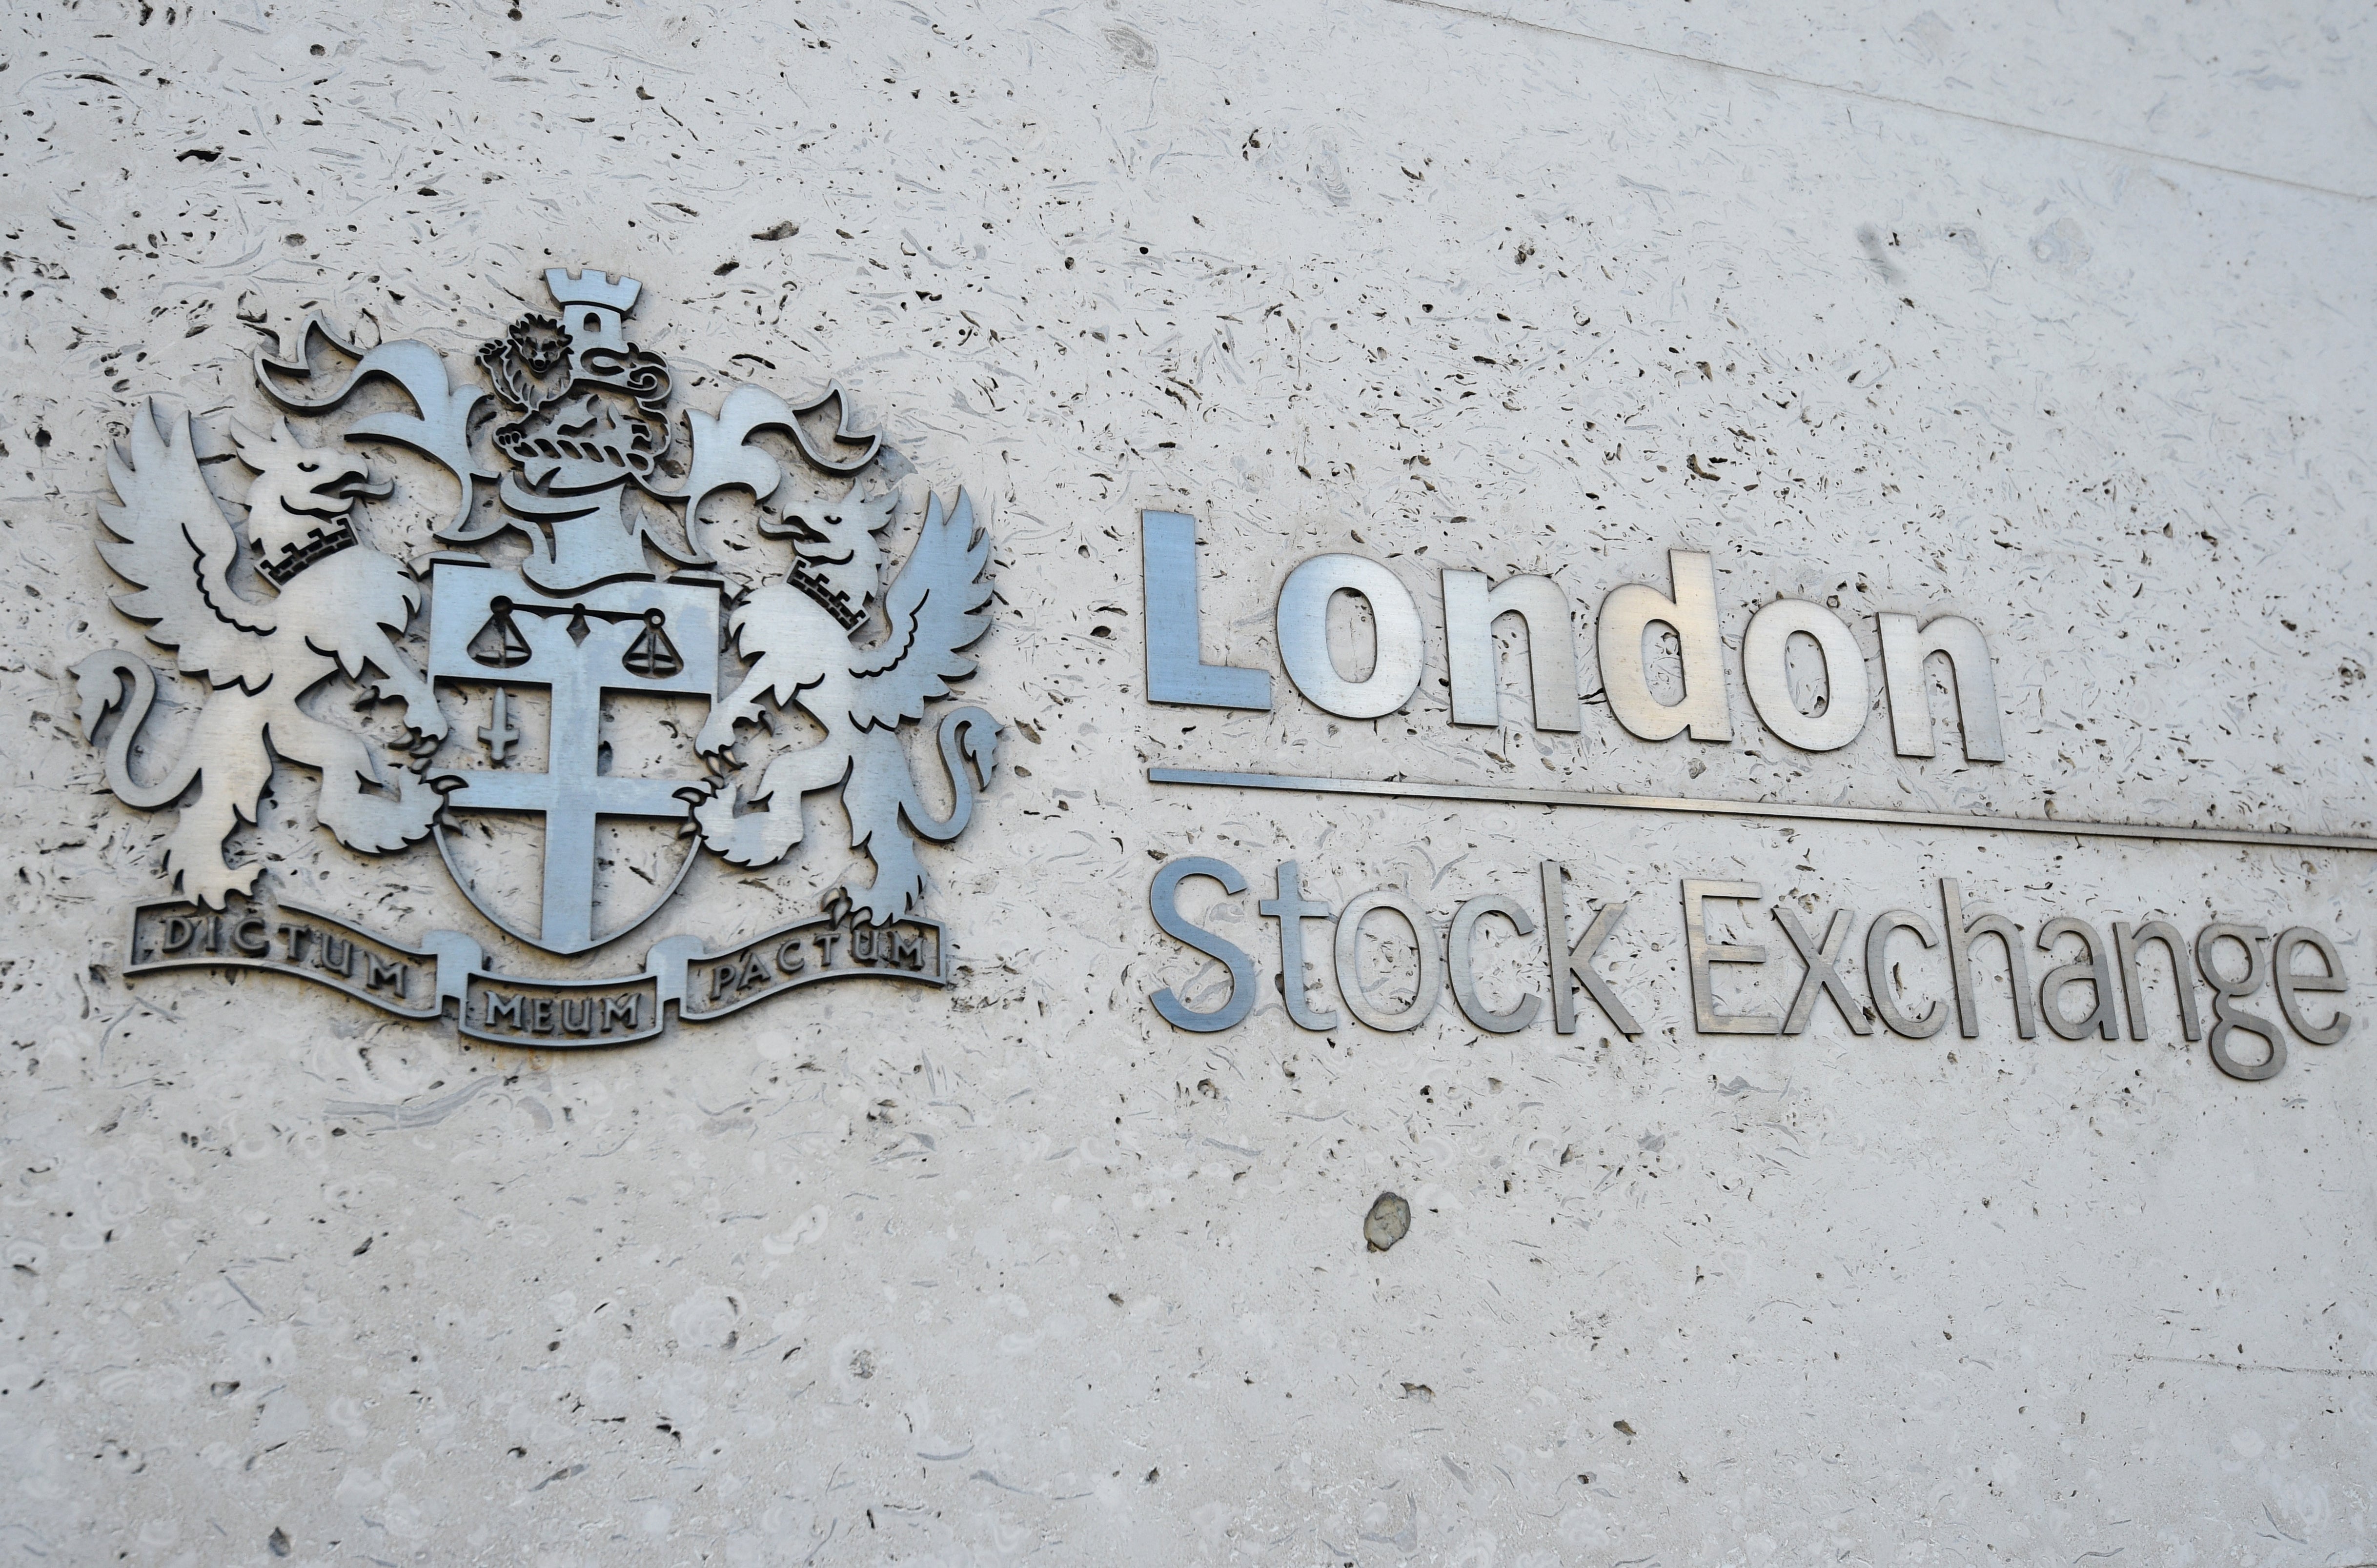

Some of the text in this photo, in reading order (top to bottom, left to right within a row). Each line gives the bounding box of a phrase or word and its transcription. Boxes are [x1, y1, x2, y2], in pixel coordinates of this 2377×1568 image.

[1142, 510, 2005, 762] London
[163, 915, 925, 1033] DICTUM MEUM PACTUM
[1148, 856, 2352, 1081] Stock Exchange
